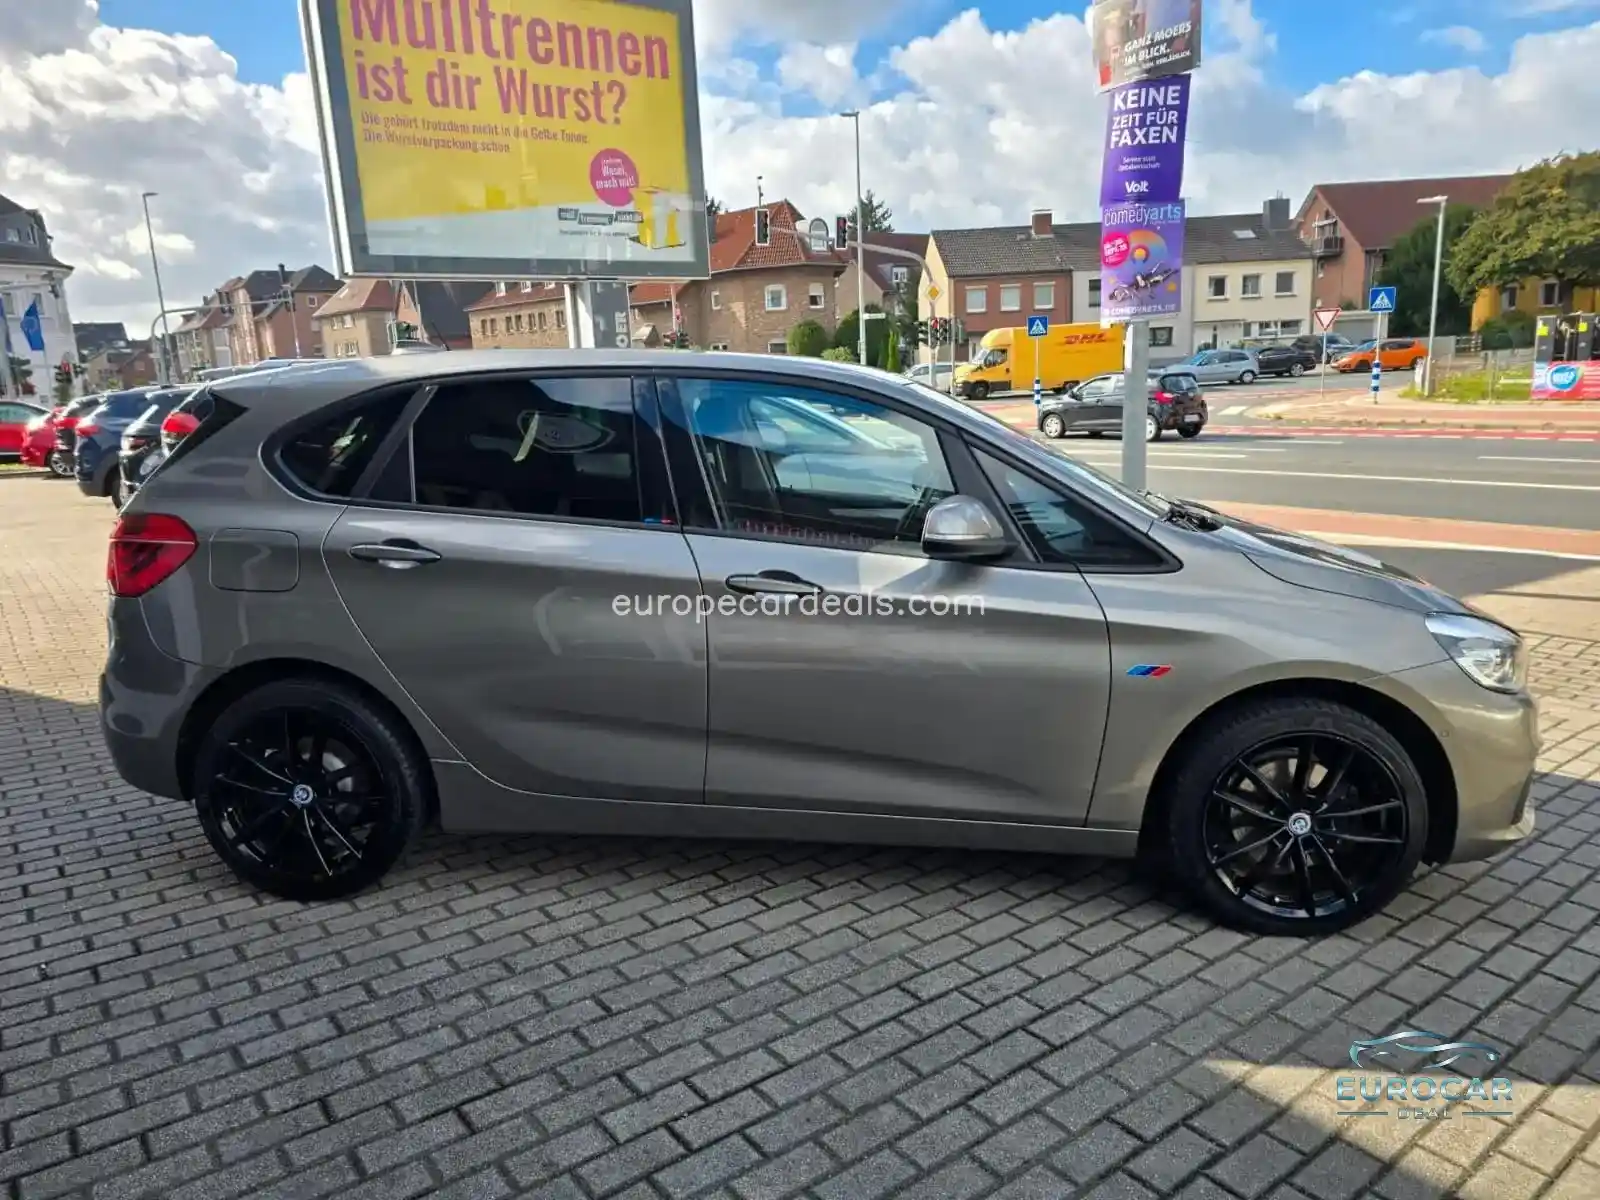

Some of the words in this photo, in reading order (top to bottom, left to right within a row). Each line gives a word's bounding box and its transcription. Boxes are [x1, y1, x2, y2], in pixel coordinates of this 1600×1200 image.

[1124, 32, 1152, 52] GANZ
[1154, 20, 1192, 42] MOERS
[1124, 54, 1137, 65] IM
[353, 50, 412, 104] ist
[426, 58, 482, 110] dir
[493, 65, 626, 125] Wurst?
[1113, 85, 1181, 111] KEINE
[361, 111, 380, 124] Die
[472, 124, 499, 136] nicht
[501, 125, 511, 137] in
[530, 127, 558, 141] Gelbe
[1112, 113, 1143, 130] ZEIT
[1146, 108, 1178, 126] FÜR
[364, 130, 384, 143] Die
[384, 130, 479, 153] Wurstverpackung
[1110, 126, 1178, 149] FAXEN
[1125, 180, 1149, 193] Volt
[1104, 203, 1182, 226] comedyarts
